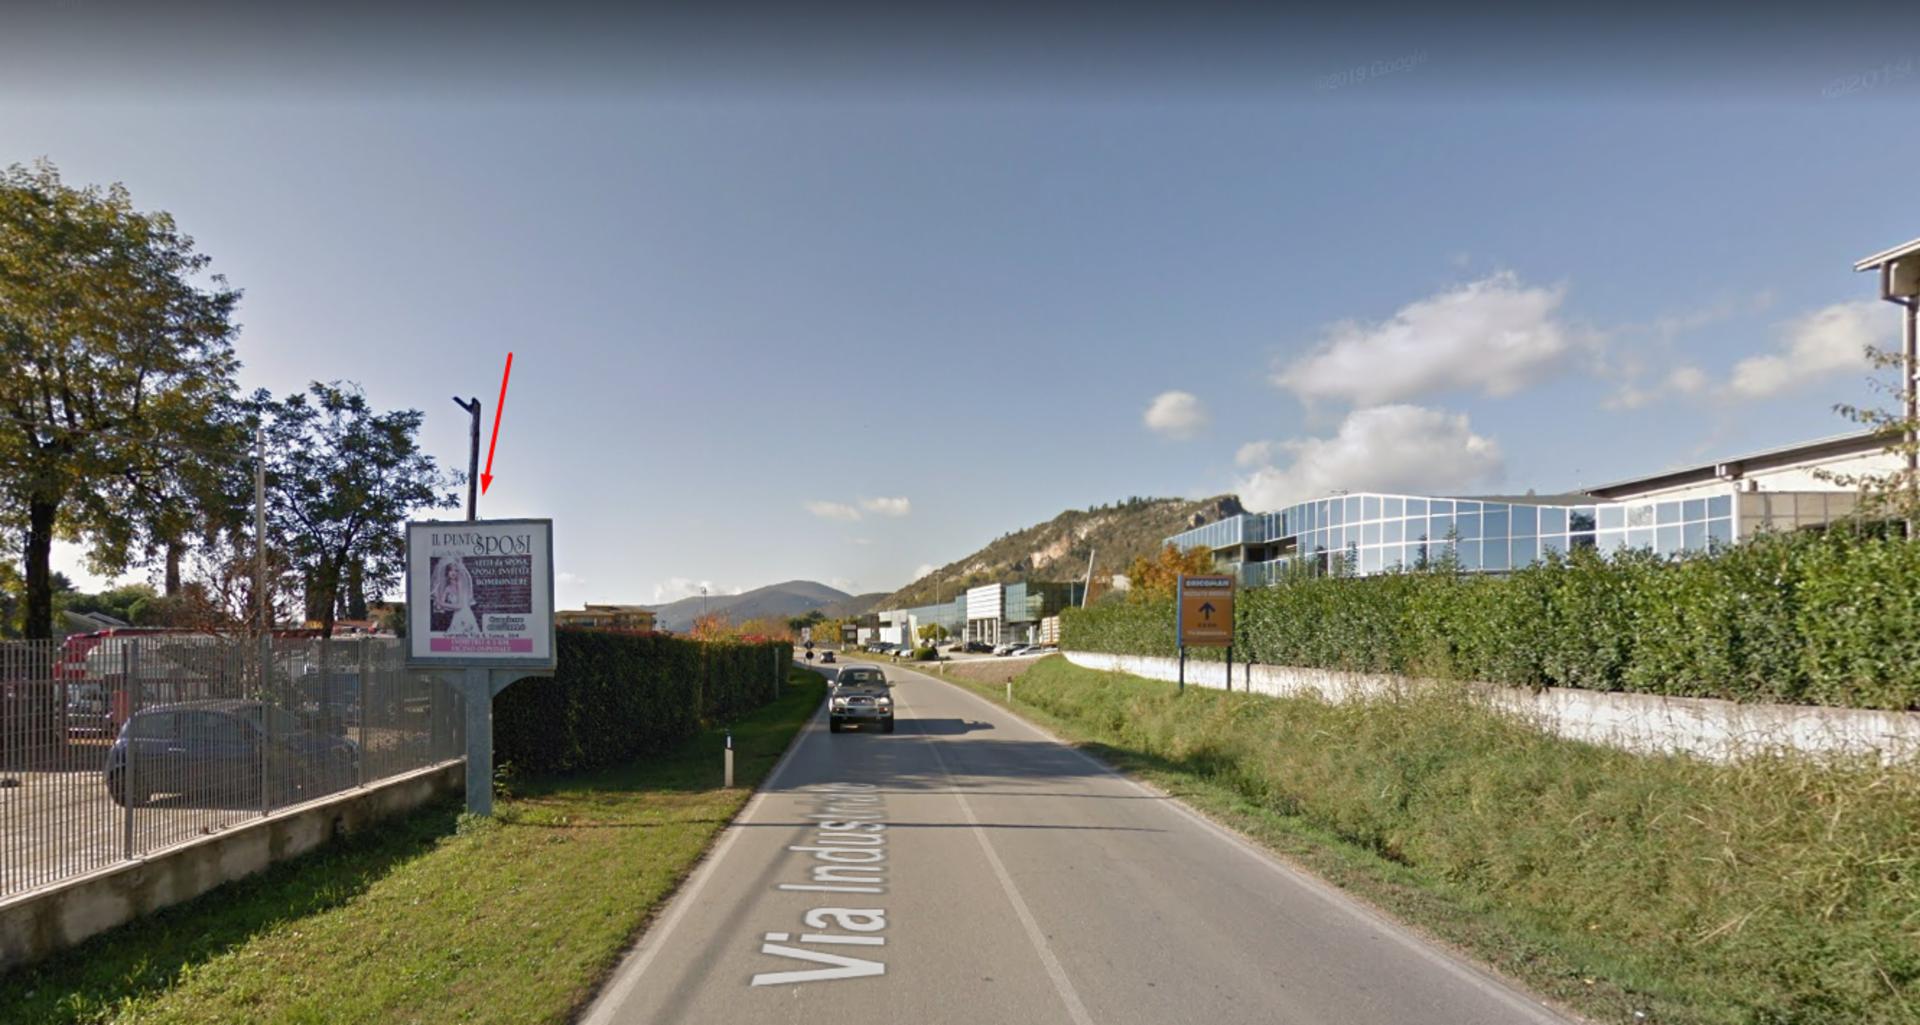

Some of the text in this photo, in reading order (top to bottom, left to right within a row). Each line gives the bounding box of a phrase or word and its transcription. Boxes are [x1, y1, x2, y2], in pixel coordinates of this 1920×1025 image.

[432, 533, 439, 546] IL
[444, 532, 480, 546] PUNTO
[473, 534, 531, 555] SPOSI
